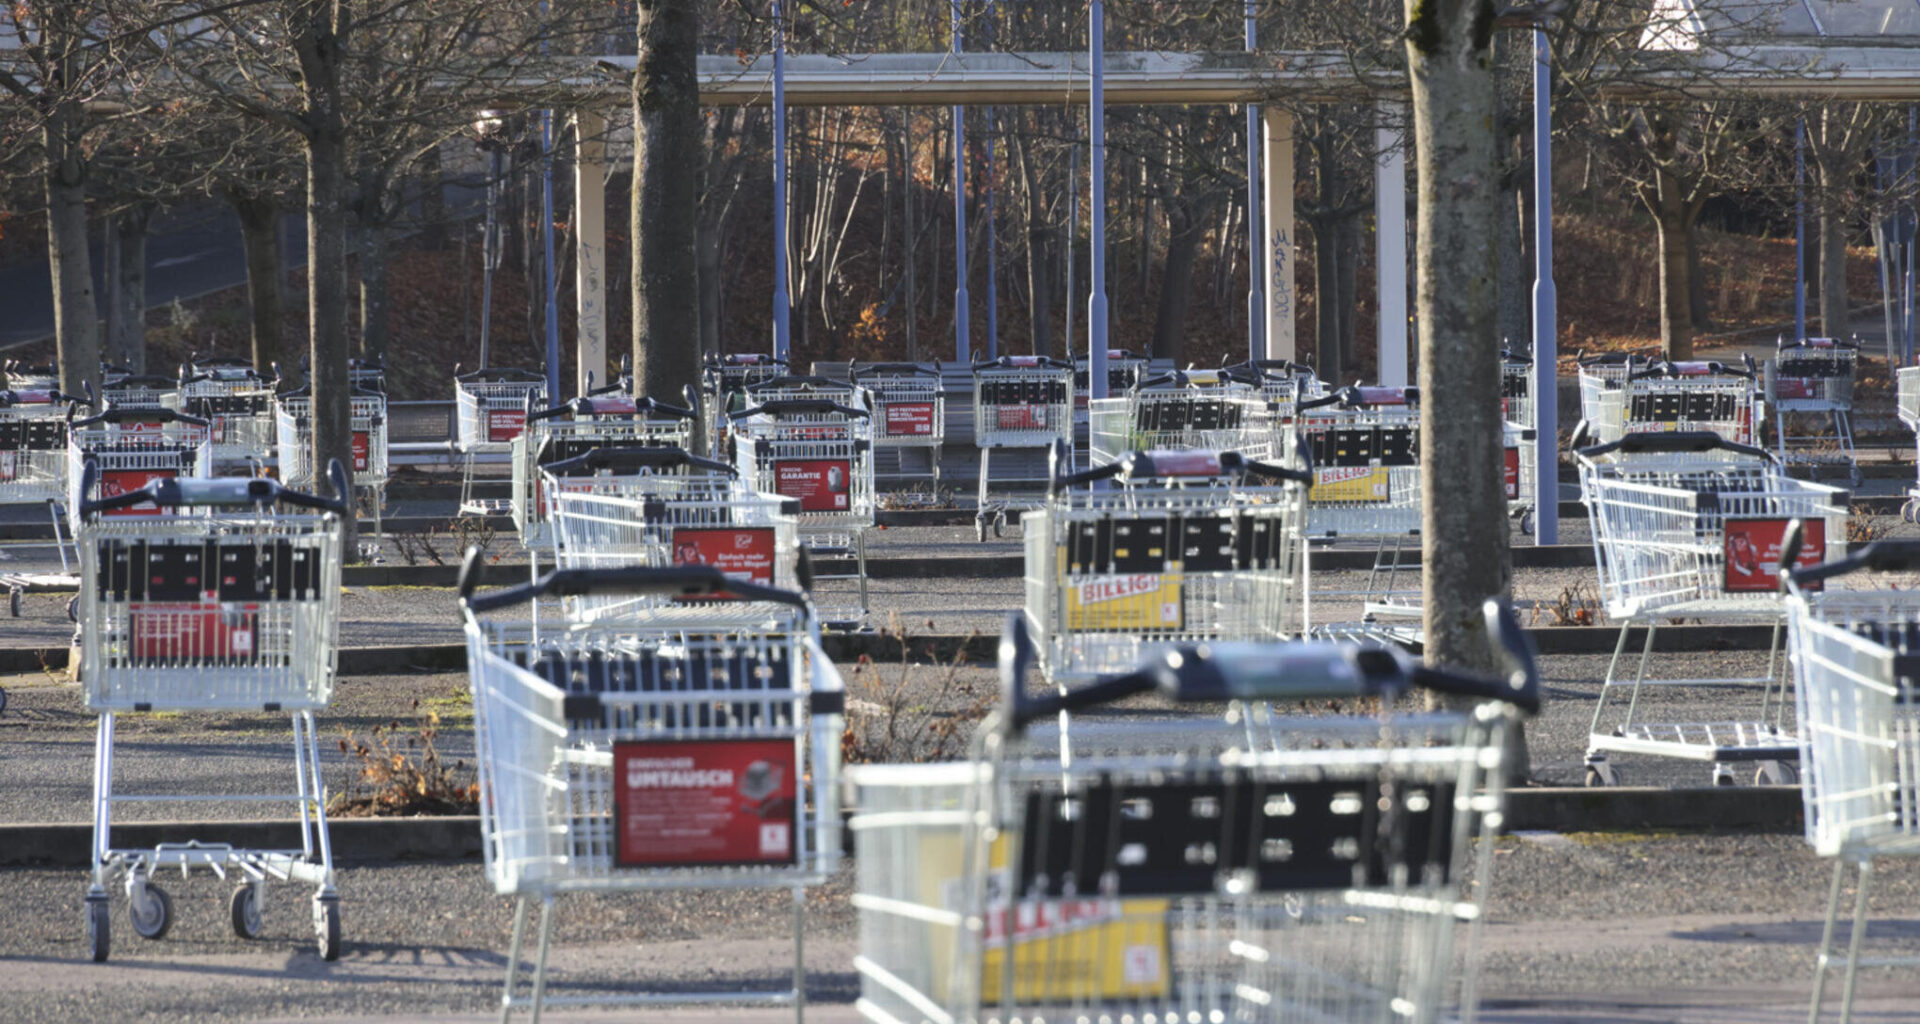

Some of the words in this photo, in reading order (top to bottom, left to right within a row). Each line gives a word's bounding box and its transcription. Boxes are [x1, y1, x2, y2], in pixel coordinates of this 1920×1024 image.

[781, 472, 821, 480] GARANTIE
[717, 552, 744, 561] Einfach
[1082, 574, 1156, 601] BILLIG!
[627, 769, 734, 789] UMTAUSCH
